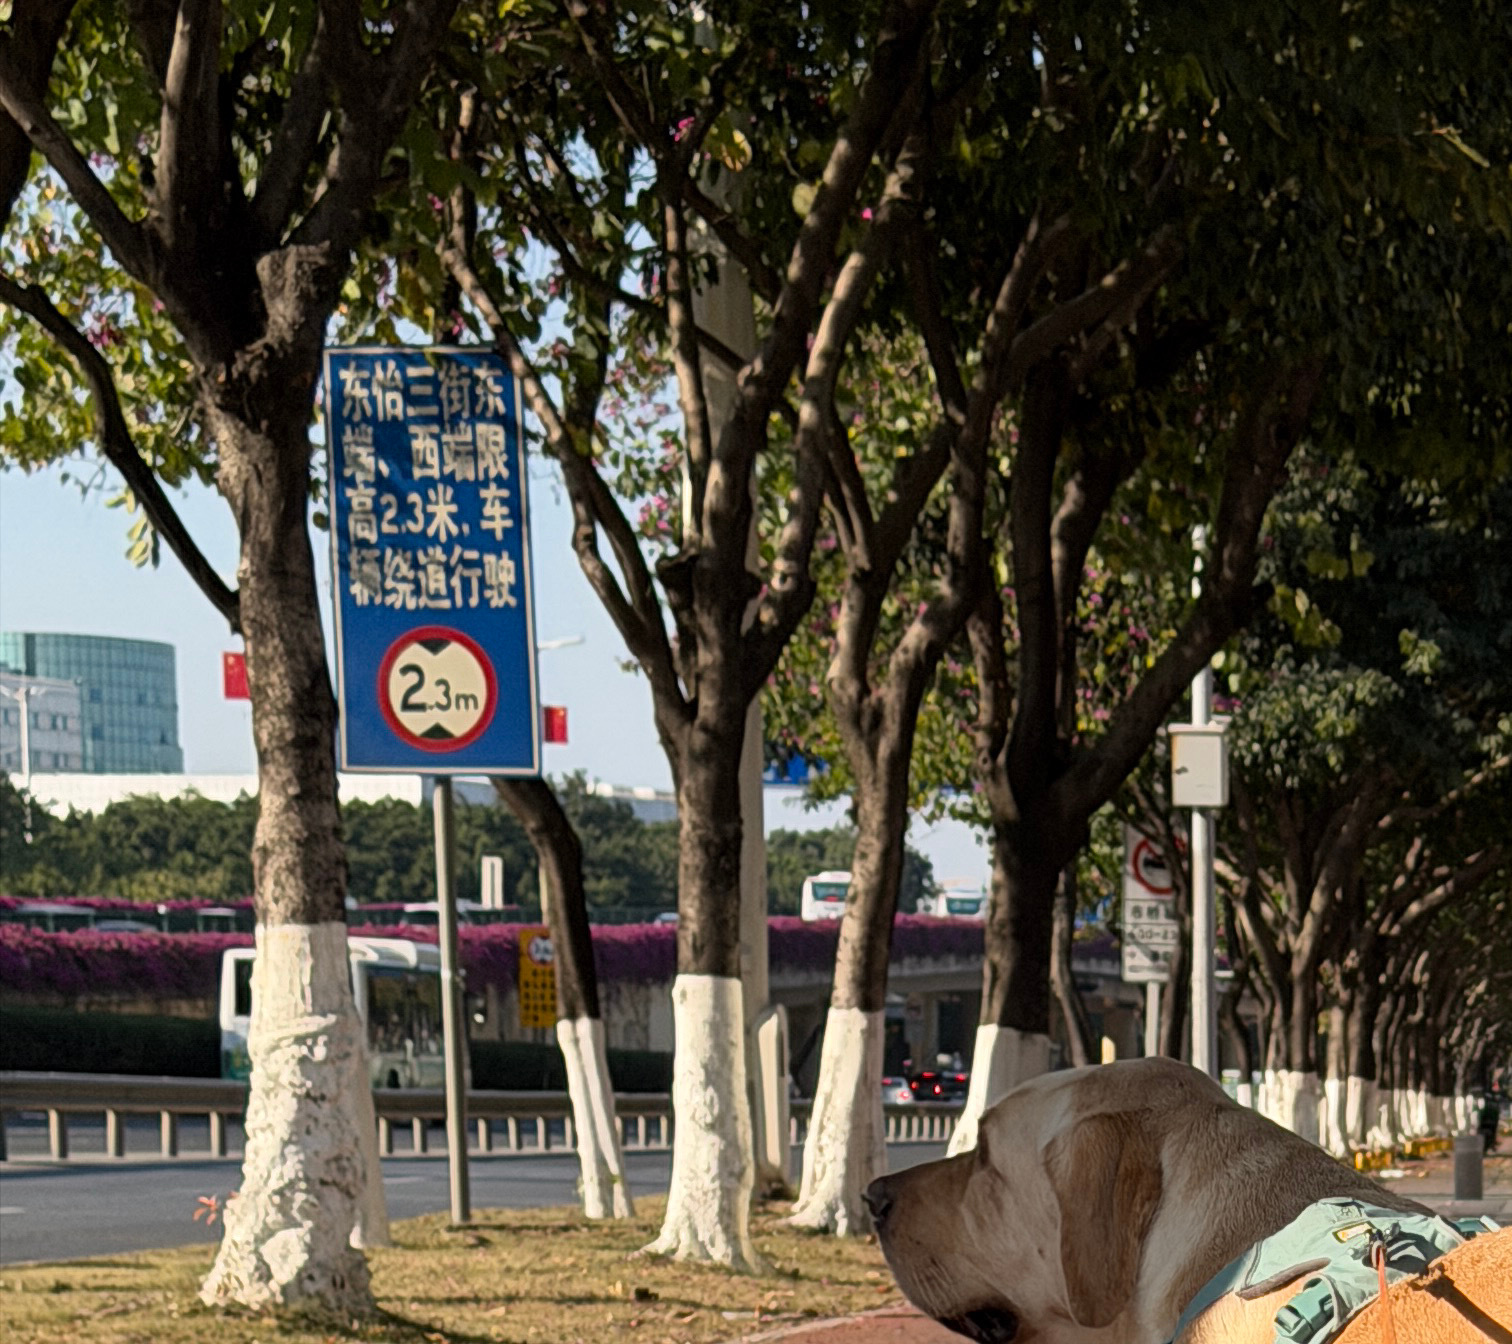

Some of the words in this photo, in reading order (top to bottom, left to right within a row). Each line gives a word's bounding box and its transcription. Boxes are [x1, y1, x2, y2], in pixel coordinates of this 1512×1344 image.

[339, 359, 506, 425] 东怡三街东
[350, 544, 517, 610] 辆绕道行驶
[399, 664, 479, 713] 2.3m
